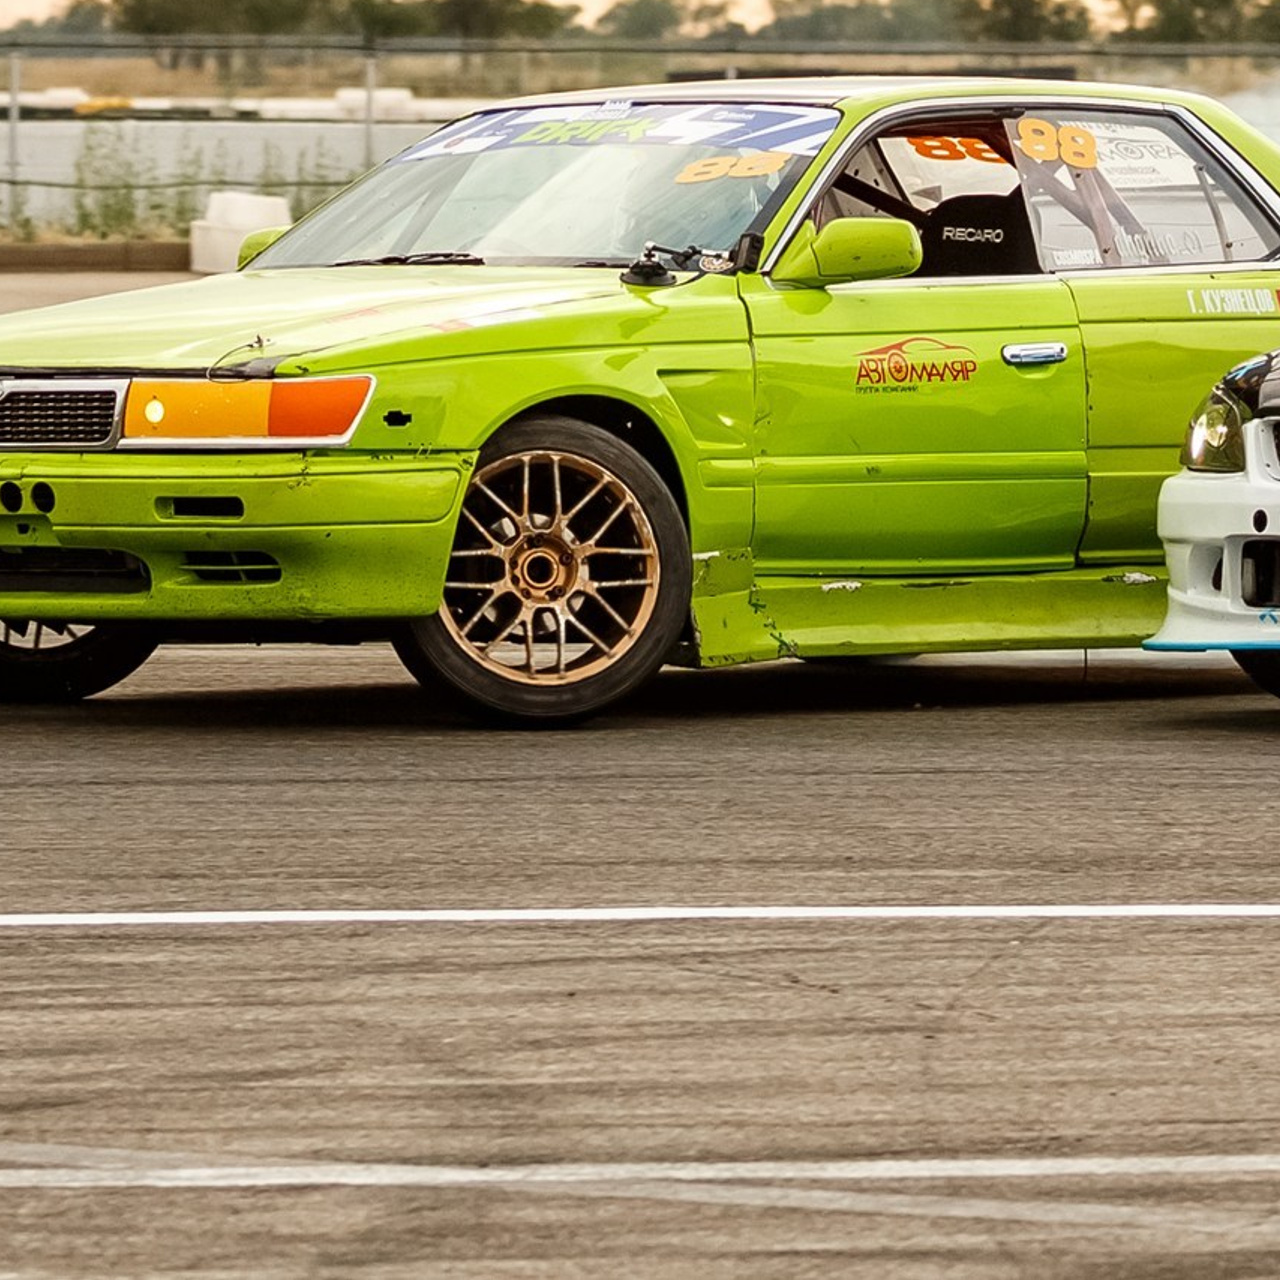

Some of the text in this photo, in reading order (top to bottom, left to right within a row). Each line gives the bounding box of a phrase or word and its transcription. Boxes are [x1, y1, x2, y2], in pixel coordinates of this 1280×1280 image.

[1018, 118, 1097, 168] 88
[674, 151, 792, 184] 88
[942, 227, 1004, 242] RECARO
[1201, 289, 1275, 315] КУЗНЕЦОВ
[856, 351, 977, 383] АВТОМАЛЯР
